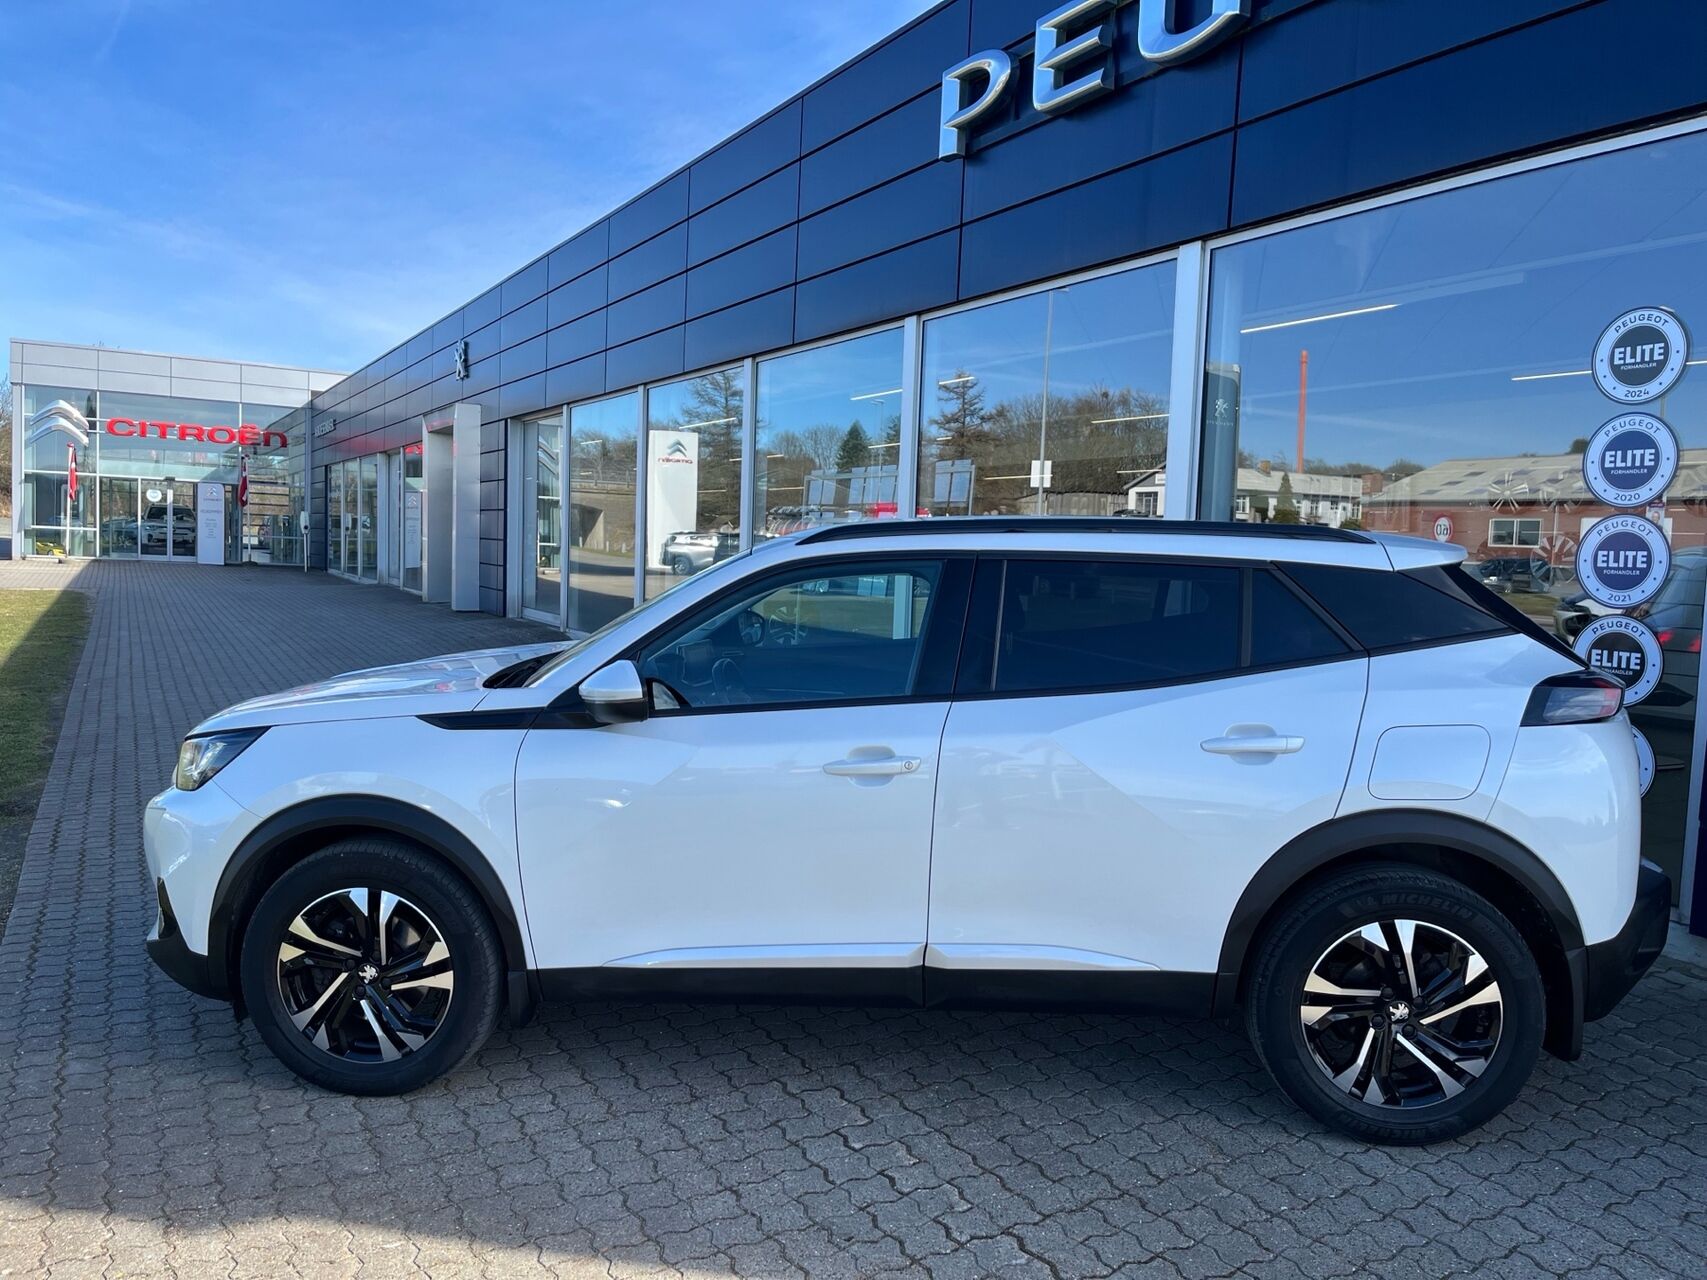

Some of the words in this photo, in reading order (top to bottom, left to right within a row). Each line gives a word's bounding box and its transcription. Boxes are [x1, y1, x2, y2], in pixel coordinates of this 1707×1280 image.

[1614, 313, 1669, 334] PEUGEOT
[1613, 342, 1665, 366] ELITE
[1620, 362, 1657, 371] FORHANDLER
[1624, 388, 1650, 398] 2024
[1604, 418, 1661, 437] PEUGEOT
[1604, 448, 1656, 468] ELITE
[1614, 492, 1640, 502] 2020
[1596, 519, 1654, 537] PEUGEOT
[1596, 550, 1648, 568] ELITE
[1607, 593, 1632, 602] 2021
[1591, 620, 1646, 638] PEUGEOT
[1590, 648, 1641, 670] ELITE
[1381, 892, 1474, 919] MICHELIN
